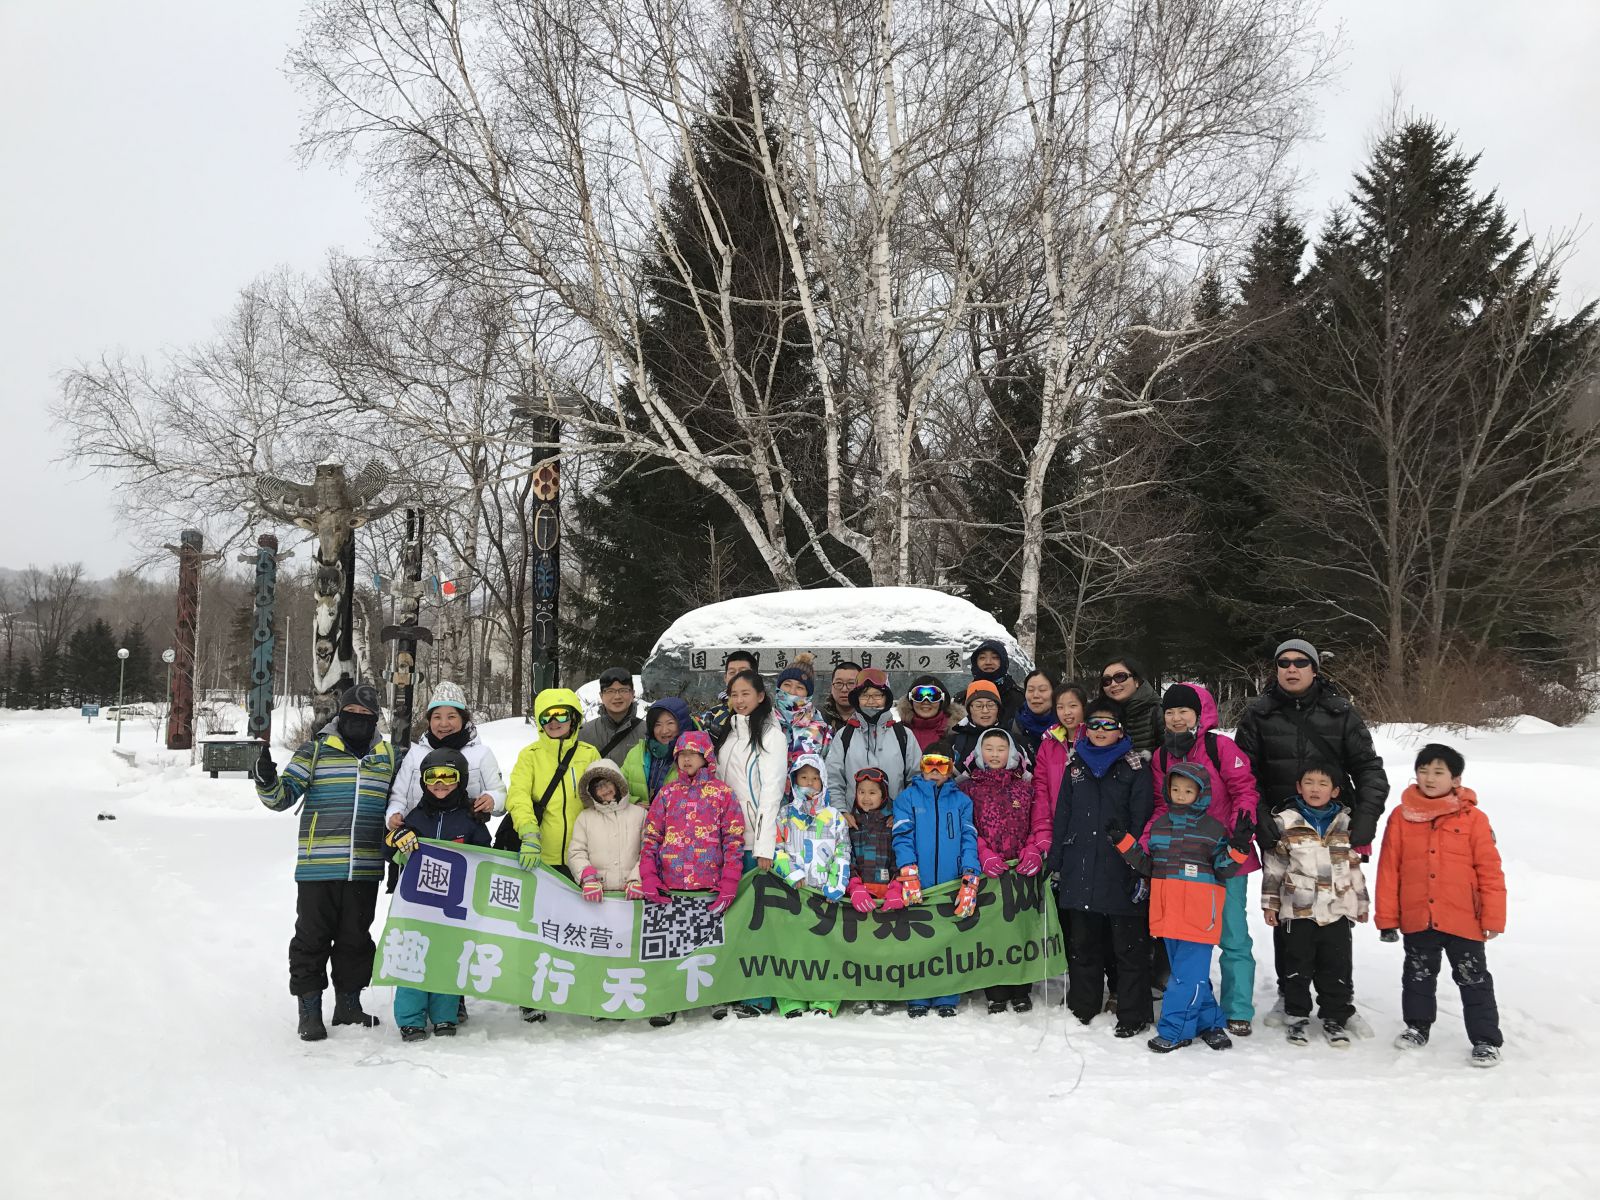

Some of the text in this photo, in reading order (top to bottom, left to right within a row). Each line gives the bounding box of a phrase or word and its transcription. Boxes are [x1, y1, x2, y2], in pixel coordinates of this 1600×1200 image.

[418, 859, 520, 909] 趣 趣
[379, 928, 716, 1013] 趣仔行天下
[739, 933, 1062, 988] www.ququclub.com
